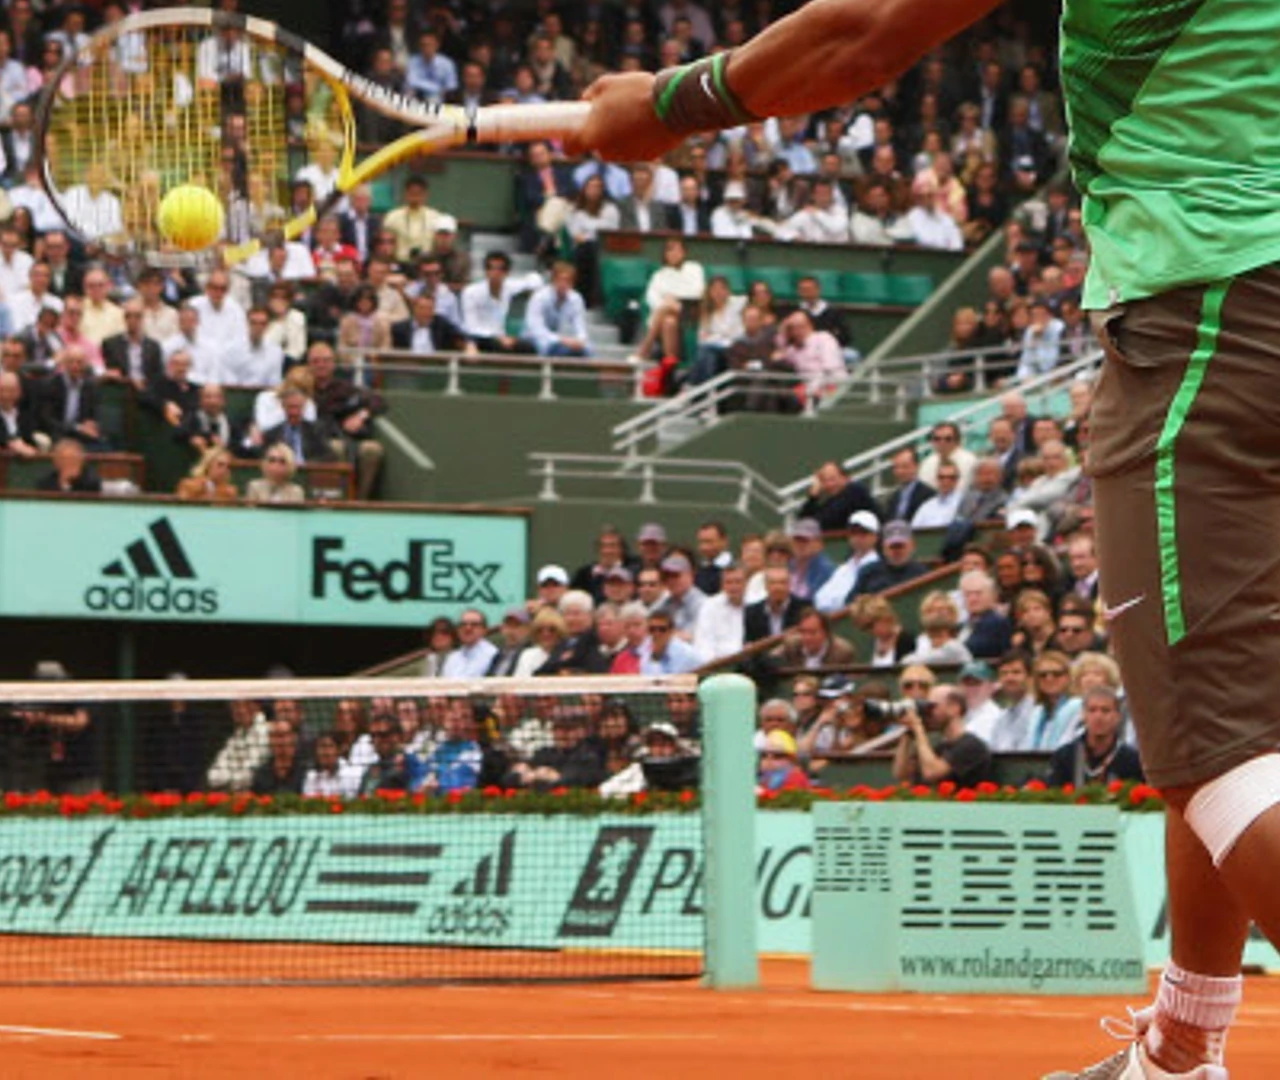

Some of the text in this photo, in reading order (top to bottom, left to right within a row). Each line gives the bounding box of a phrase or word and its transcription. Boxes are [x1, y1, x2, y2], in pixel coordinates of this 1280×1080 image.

[83, 578, 219, 614] adidas
[311, 536, 503, 604] FedEx
[815, 826, 891, 892] IBM
[901, 828, 1117, 930] IBM
[900, 948, 1144, 988] www.rolandgarros.com
